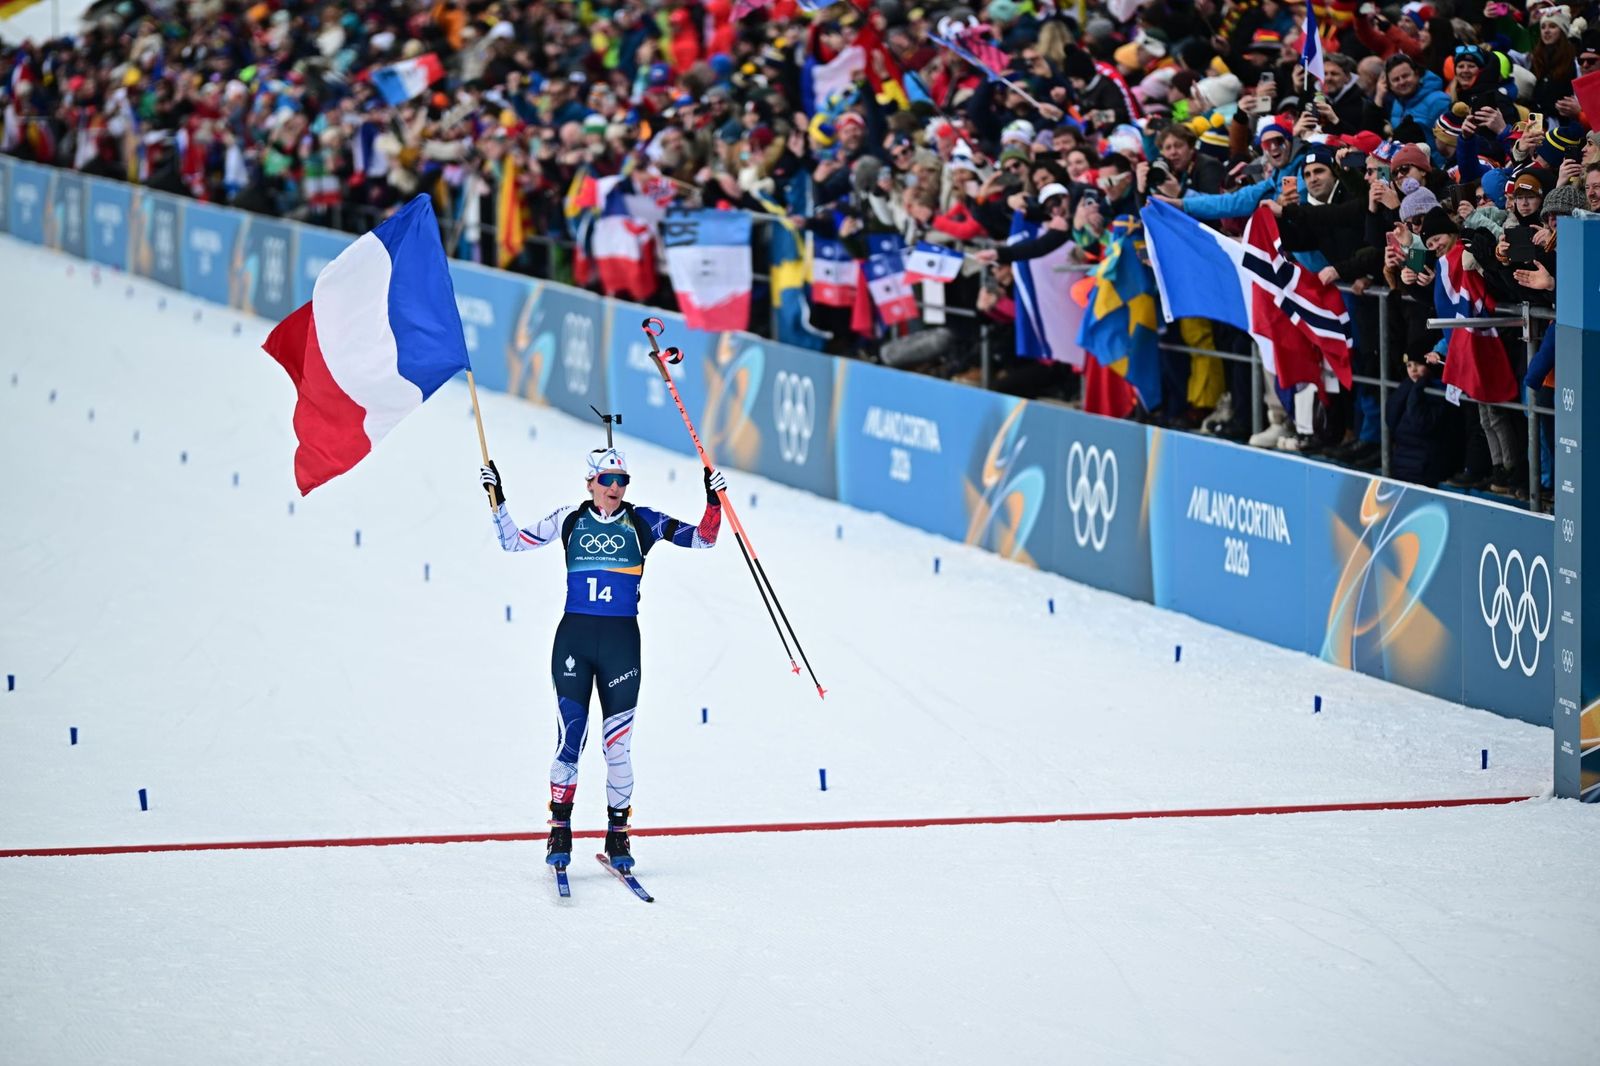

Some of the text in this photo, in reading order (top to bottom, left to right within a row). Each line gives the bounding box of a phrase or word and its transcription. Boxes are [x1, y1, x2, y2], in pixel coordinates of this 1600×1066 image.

[1186, 485, 1292, 546] MILANO CORTINA
[1223, 535, 1250, 578] 2026
[608, 669, 635, 688] CRAFT
